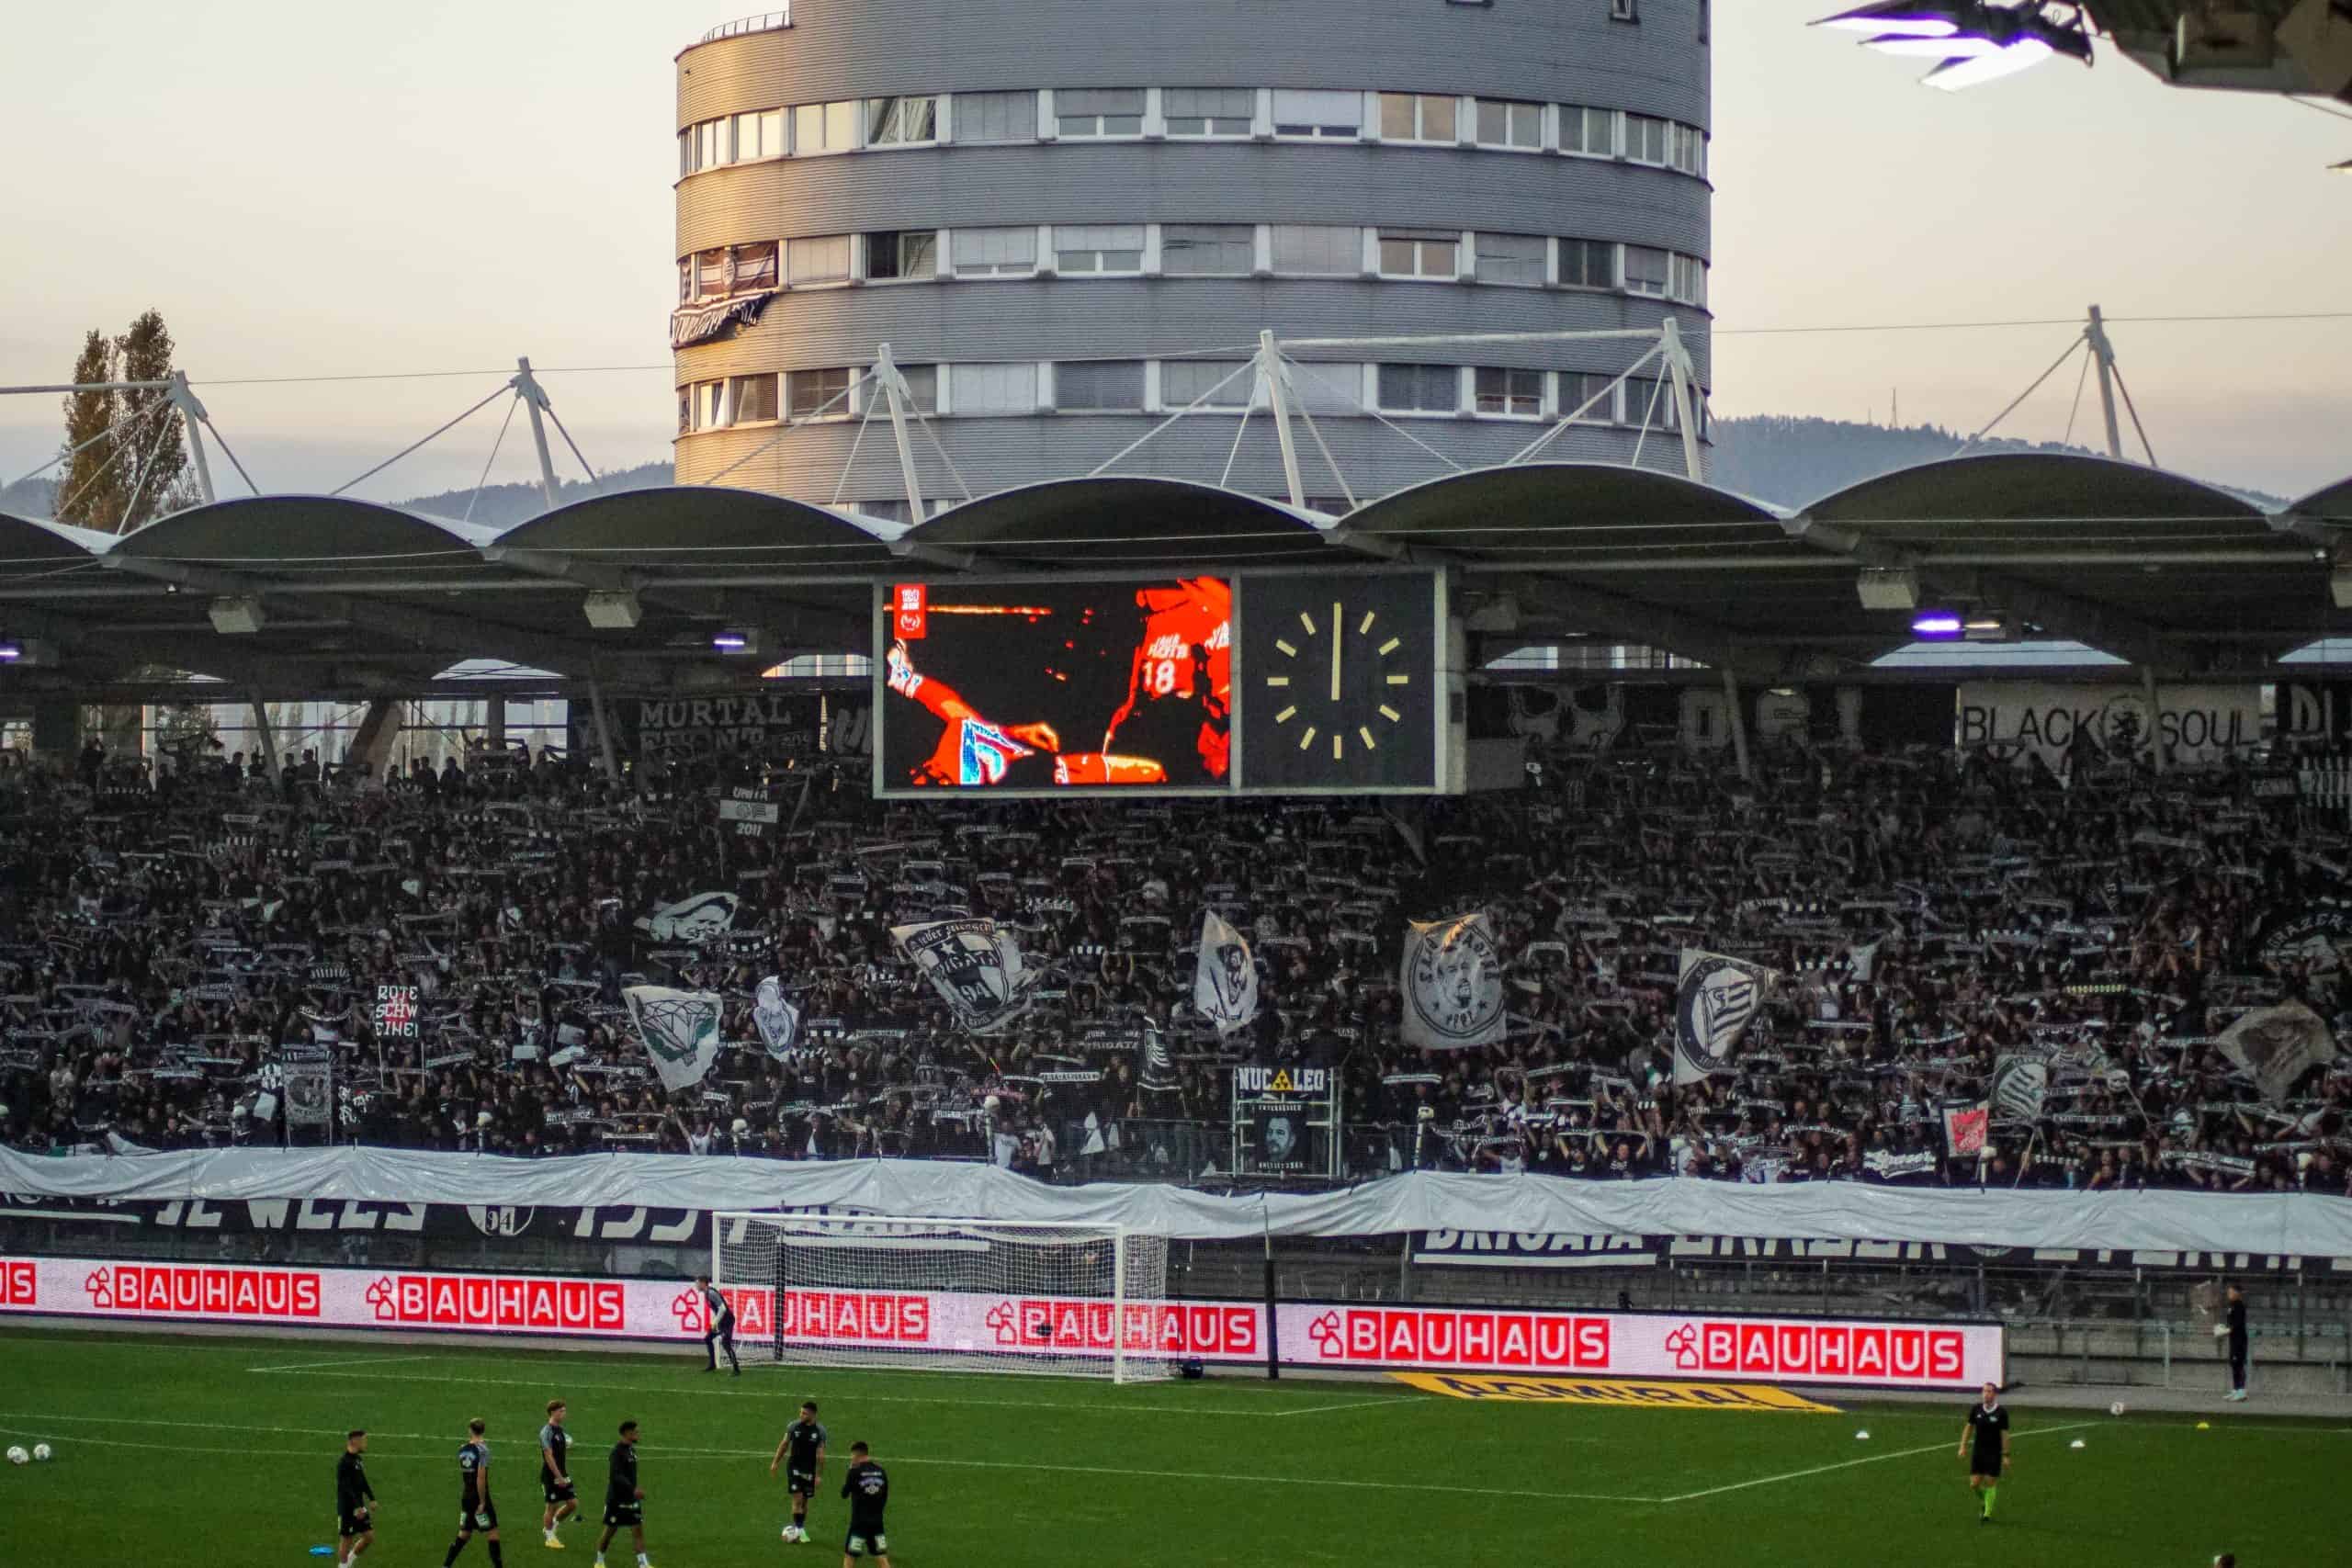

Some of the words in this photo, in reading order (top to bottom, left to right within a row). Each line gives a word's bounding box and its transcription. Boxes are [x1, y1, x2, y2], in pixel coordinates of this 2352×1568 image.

[1143, 660, 1176, 694] 18
[639, 696, 792, 728] MURTAL
[1963, 706, 2098, 747] BLACK
[2159, 709, 2258, 746] SOUL
[378, 986, 418, 1000] ROTE
[119, 1271, 316, 1311] BAUHAUS
[403, 1281, 619, 1323] BAUHAUS
[714, 1295, 924, 1335] AUHAUS
[1025, 1307, 1250, 1347] BAUHAUS
[1351, 1317, 1605, 1360] BAUHAUS
[1707, 1330, 1959, 1372] BAUHAUS
